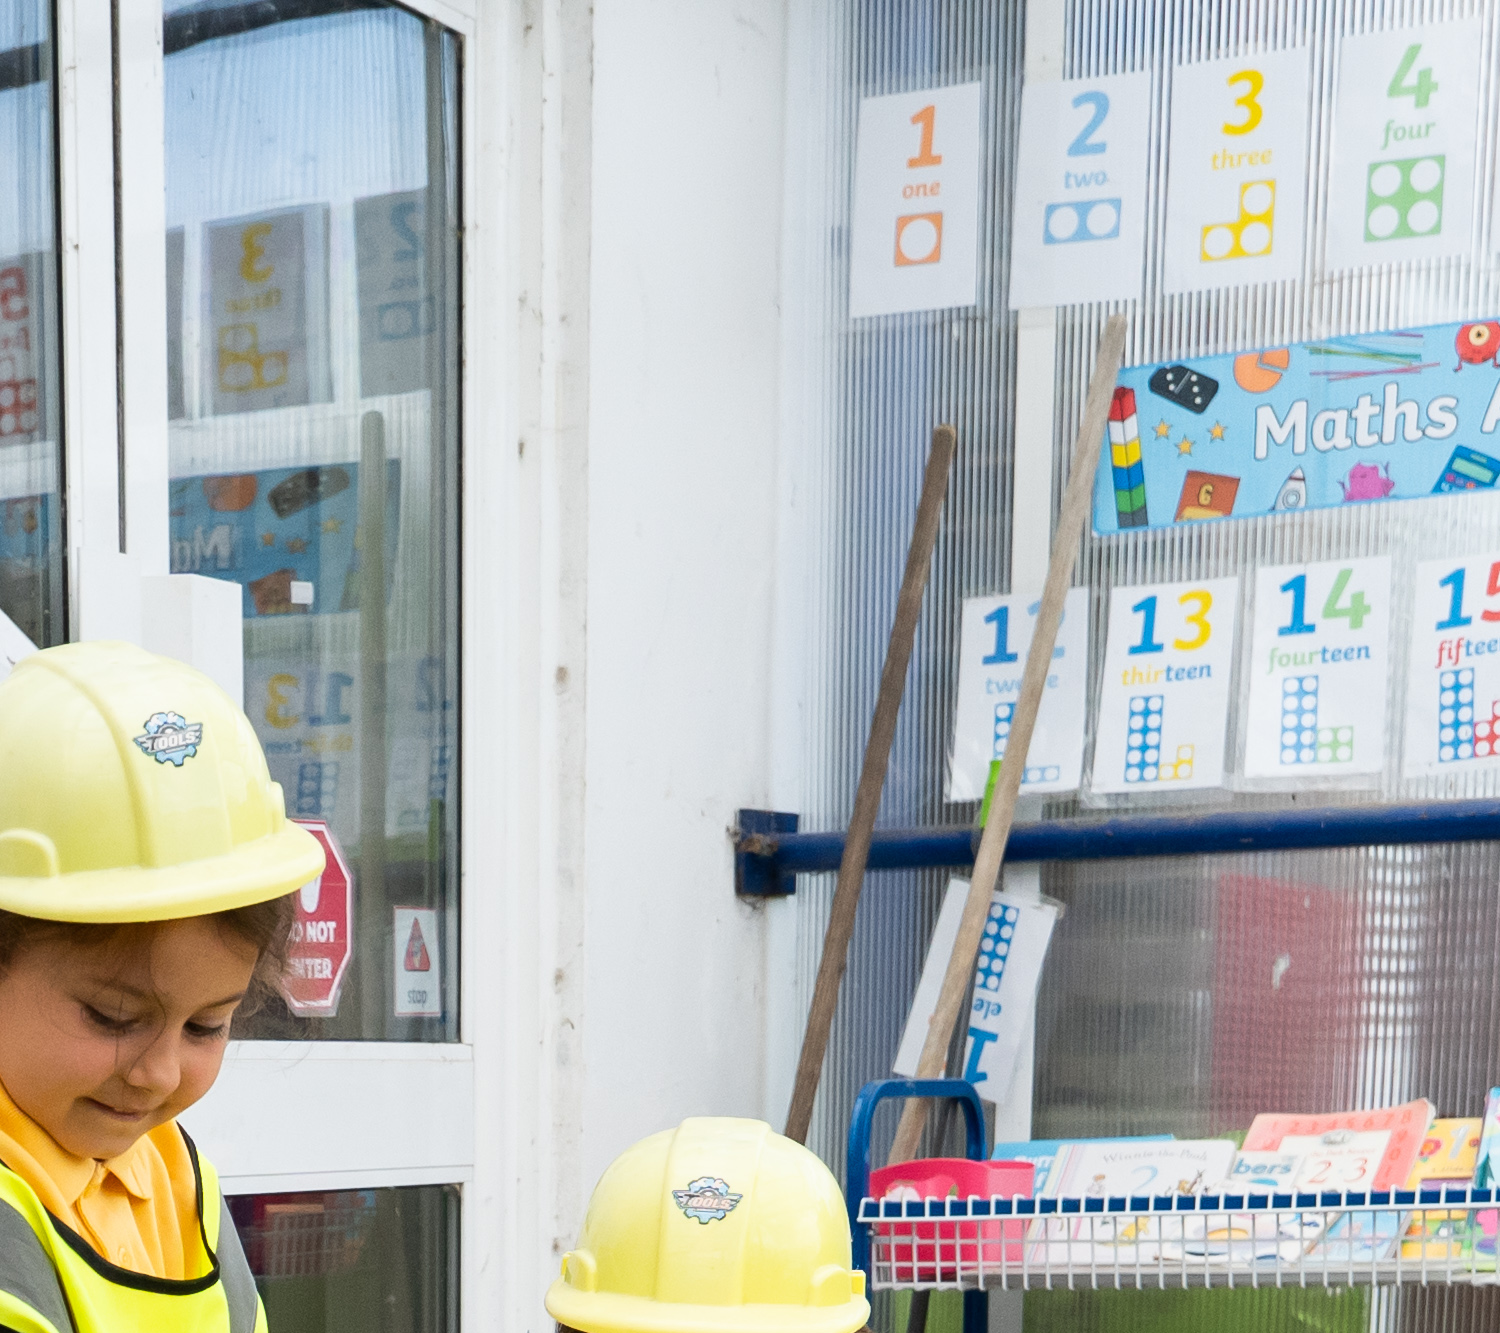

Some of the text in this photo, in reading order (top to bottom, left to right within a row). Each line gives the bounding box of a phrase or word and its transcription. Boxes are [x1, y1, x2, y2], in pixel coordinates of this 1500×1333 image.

[1387, 43, 1439, 108] 4
[1221, 69, 1265, 137] 3
[906, 104, 943, 169] 1
[1067, 90, 1111, 158] 2
[1382, 119, 1436, 150] four
[1211, 148, 1273, 171] three
[902, 179, 942, 200] one
[1064, 169, 1108, 191] two
[1253, 383, 1458, 461] Maths
[1277, 568, 1371, 637] 14
[1128, 589, 1213, 656] 13
[1268, 642, 1371, 675] fourteen
[1121, 661, 1212, 687] thirteen
[146, 731, 196, 751] TOOLS
[306, 921, 337, 943] NOT
[407, 989, 427, 1008] stop
[1233, 1158, 1292, 1176] bers
[1307, 1157, 1368, 1184] 2 3
[684, 1193, 731, 1209] TOOLS
